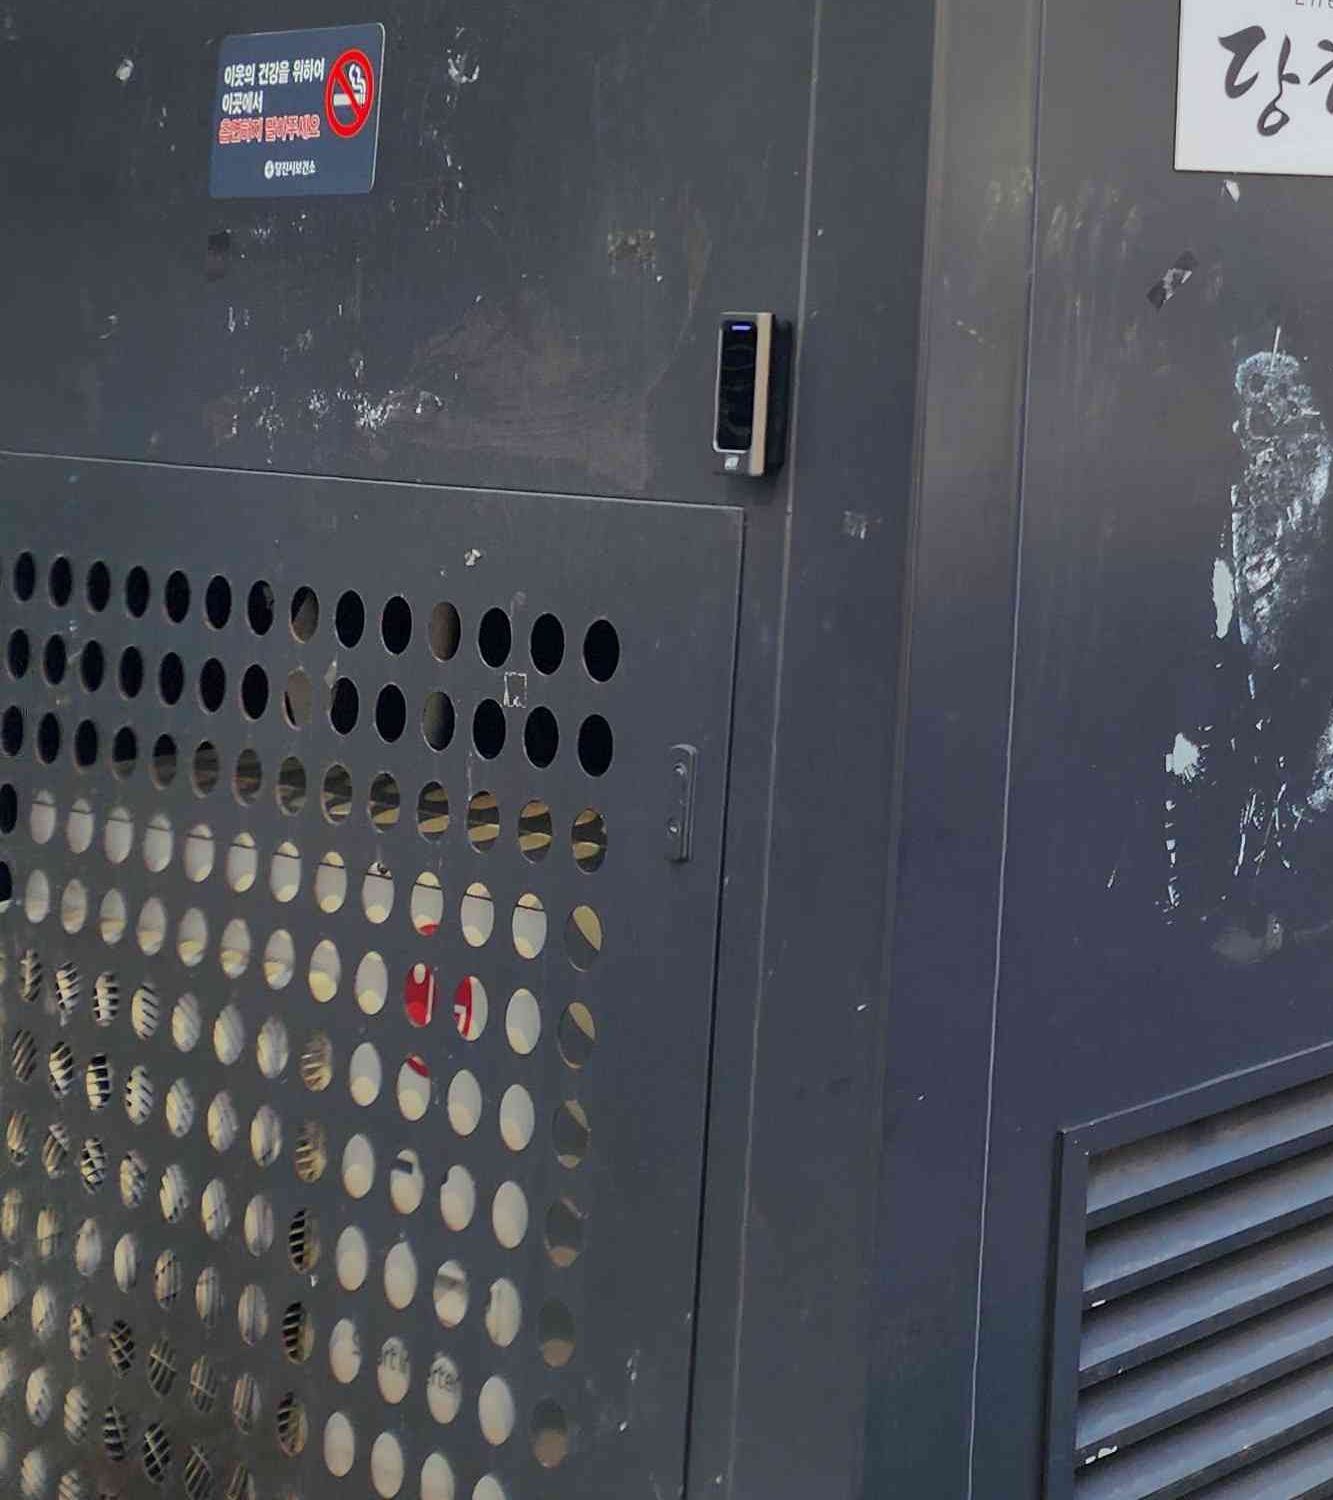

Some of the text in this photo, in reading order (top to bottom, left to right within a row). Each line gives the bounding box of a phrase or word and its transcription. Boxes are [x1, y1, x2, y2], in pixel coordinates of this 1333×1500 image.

[224, 57, 325, 87] 이웃의 건강을 위하여
[222, 90, 263, 115] 이곳에서
